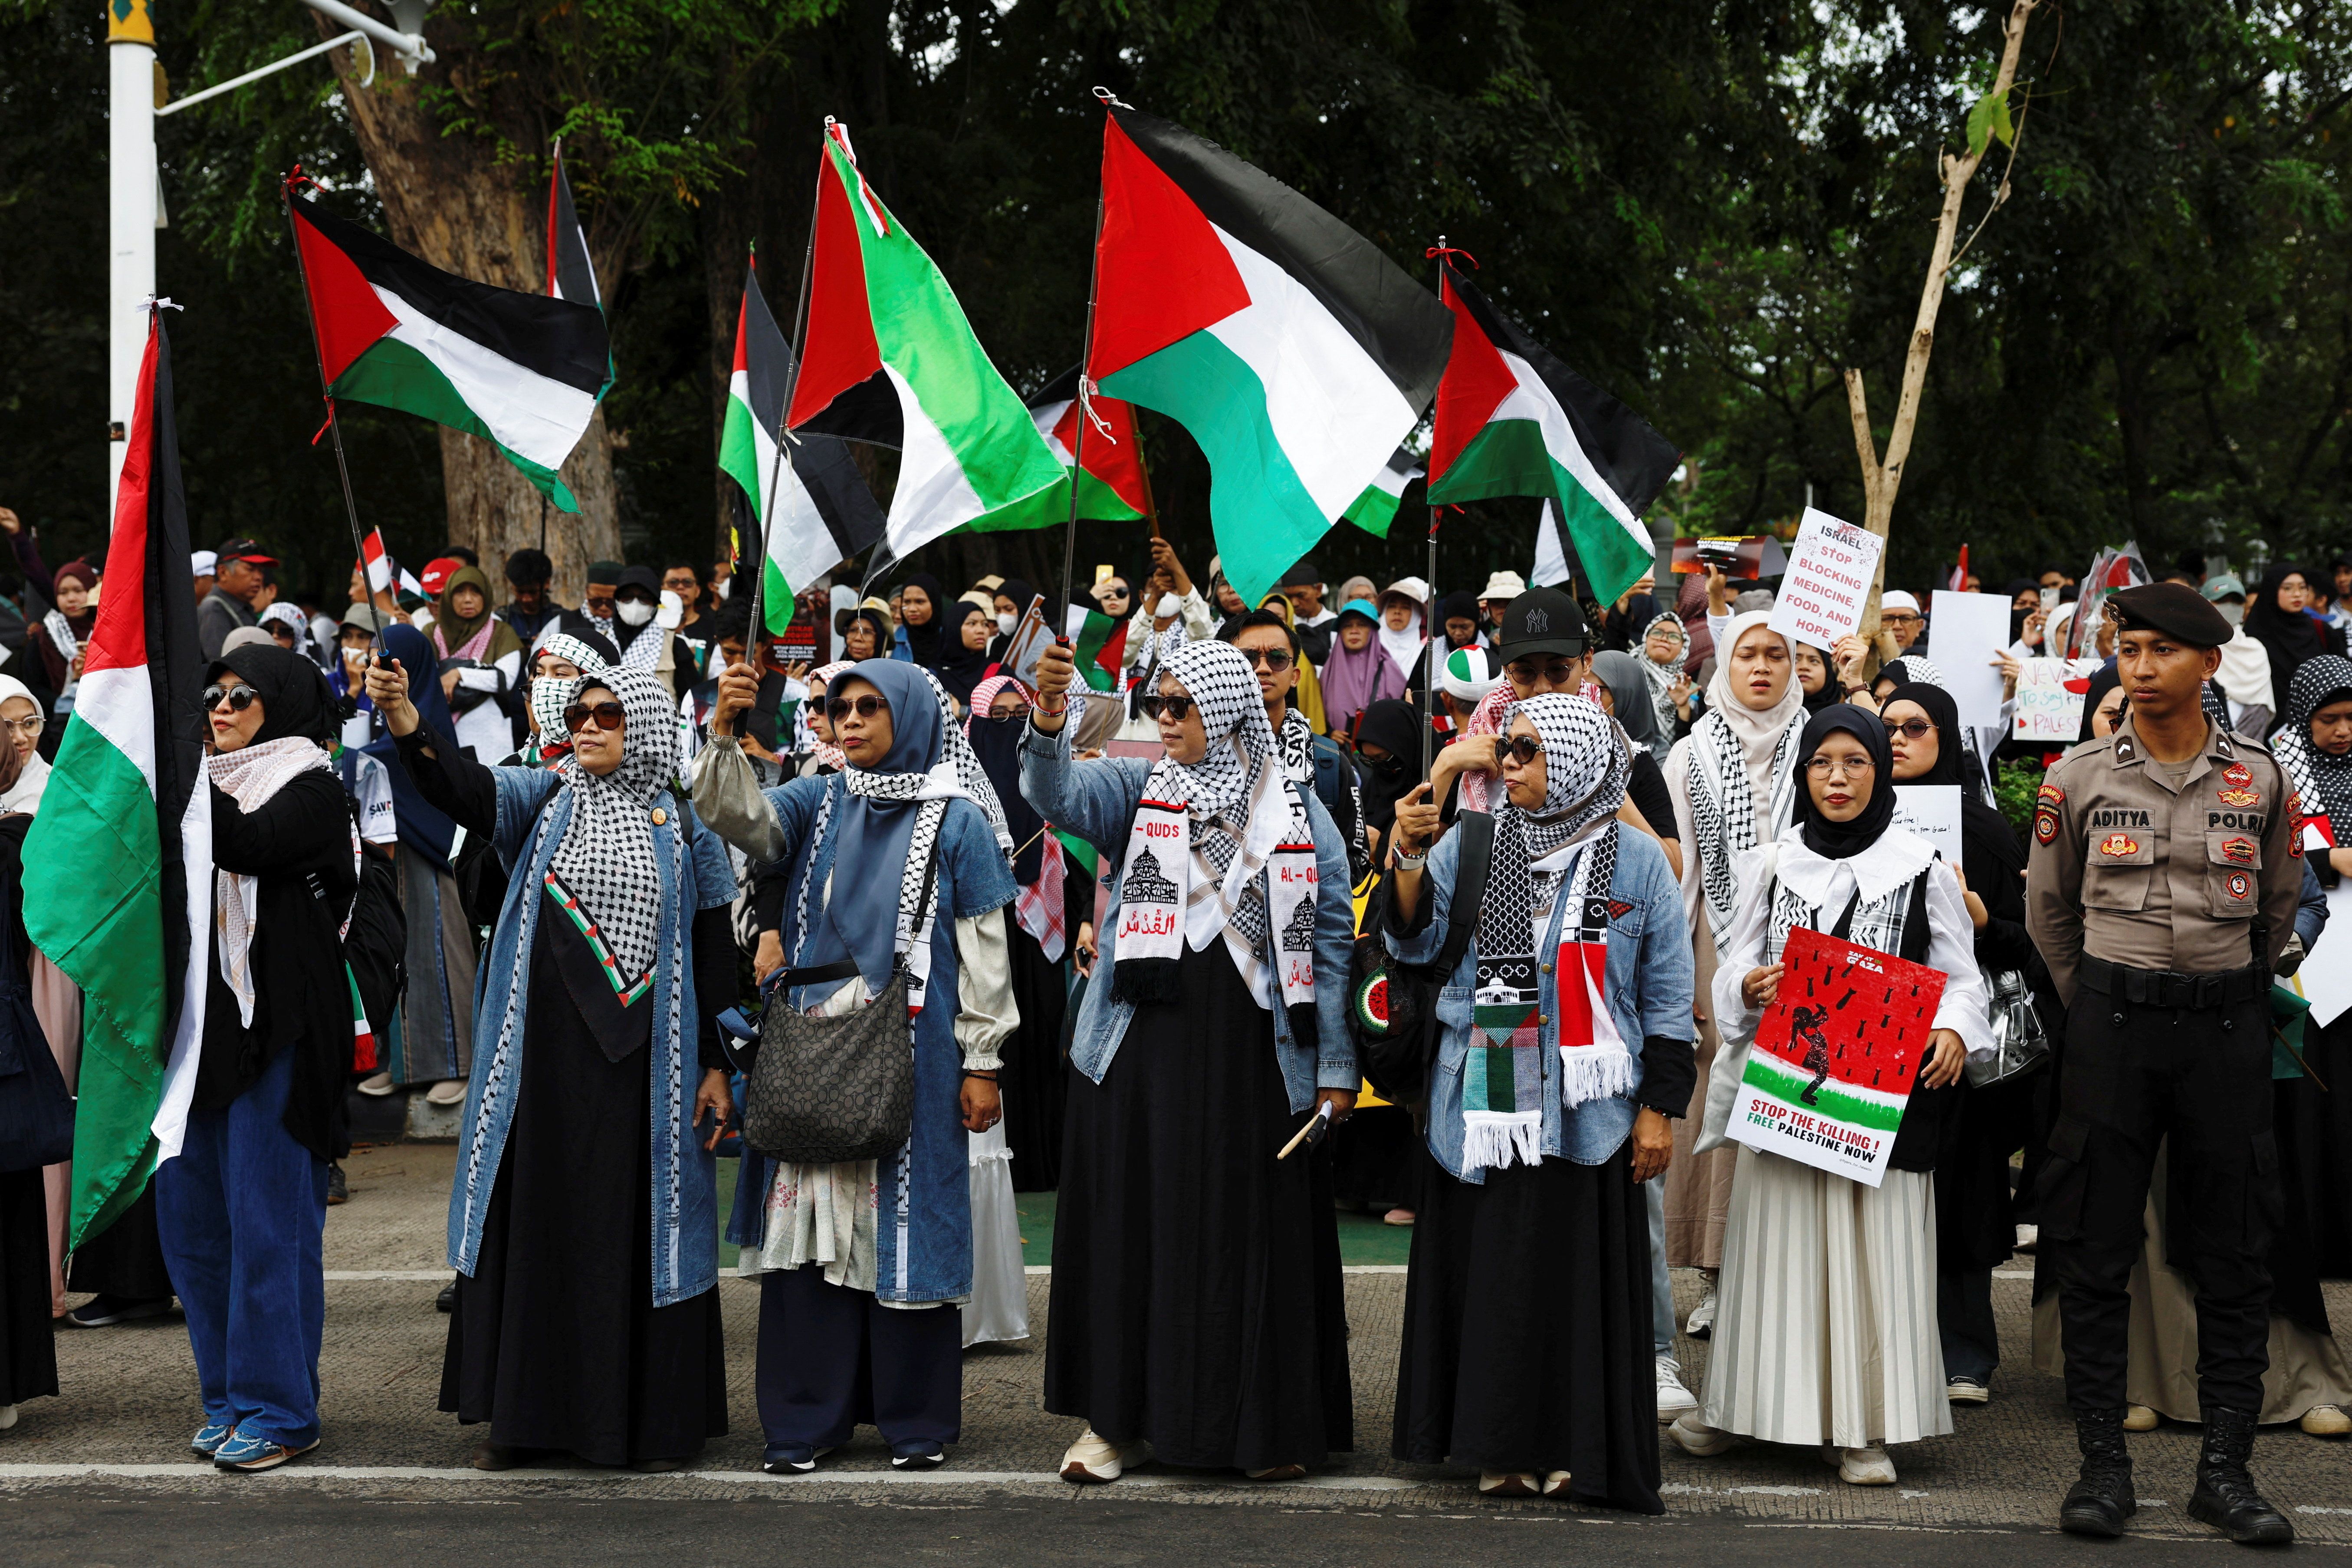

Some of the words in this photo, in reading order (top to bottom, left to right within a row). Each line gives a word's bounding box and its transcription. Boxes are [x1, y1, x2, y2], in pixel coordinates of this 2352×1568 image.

[1821, 526, 1861, 550] ISRAEL
[1820, 546, 1852, 564] STOP
[1799, 558, 1861, 589] BLOCKING
[1793, 576, 1855, 610] MEDICINE,
[1786, 594, 1822, 617] FOOD,
[1826, 610, 1852, 626] AND
[1796, 618, 1831, 638] HOPE
[369, 801, 391, 815] SAVE
[2092, 810, 2149, 827] ADITYA
[2208, 812, 2263, 832] POLRI
[1846, 956, 1883, 974] GAZA
[1848, 950, 1874, 962] ZAKAT
[1751, 1099, 1787, 1120] STOP
[1790, 1111, 1816, 1131] THE
[1817, 1121, 1871, 1150] KILLING
[1747, 1111, 1775, 1129] FREE
[1778, 1122, 1842, 1153] PALESTINE
[1844, 1144, 1876, 1164] NOW
